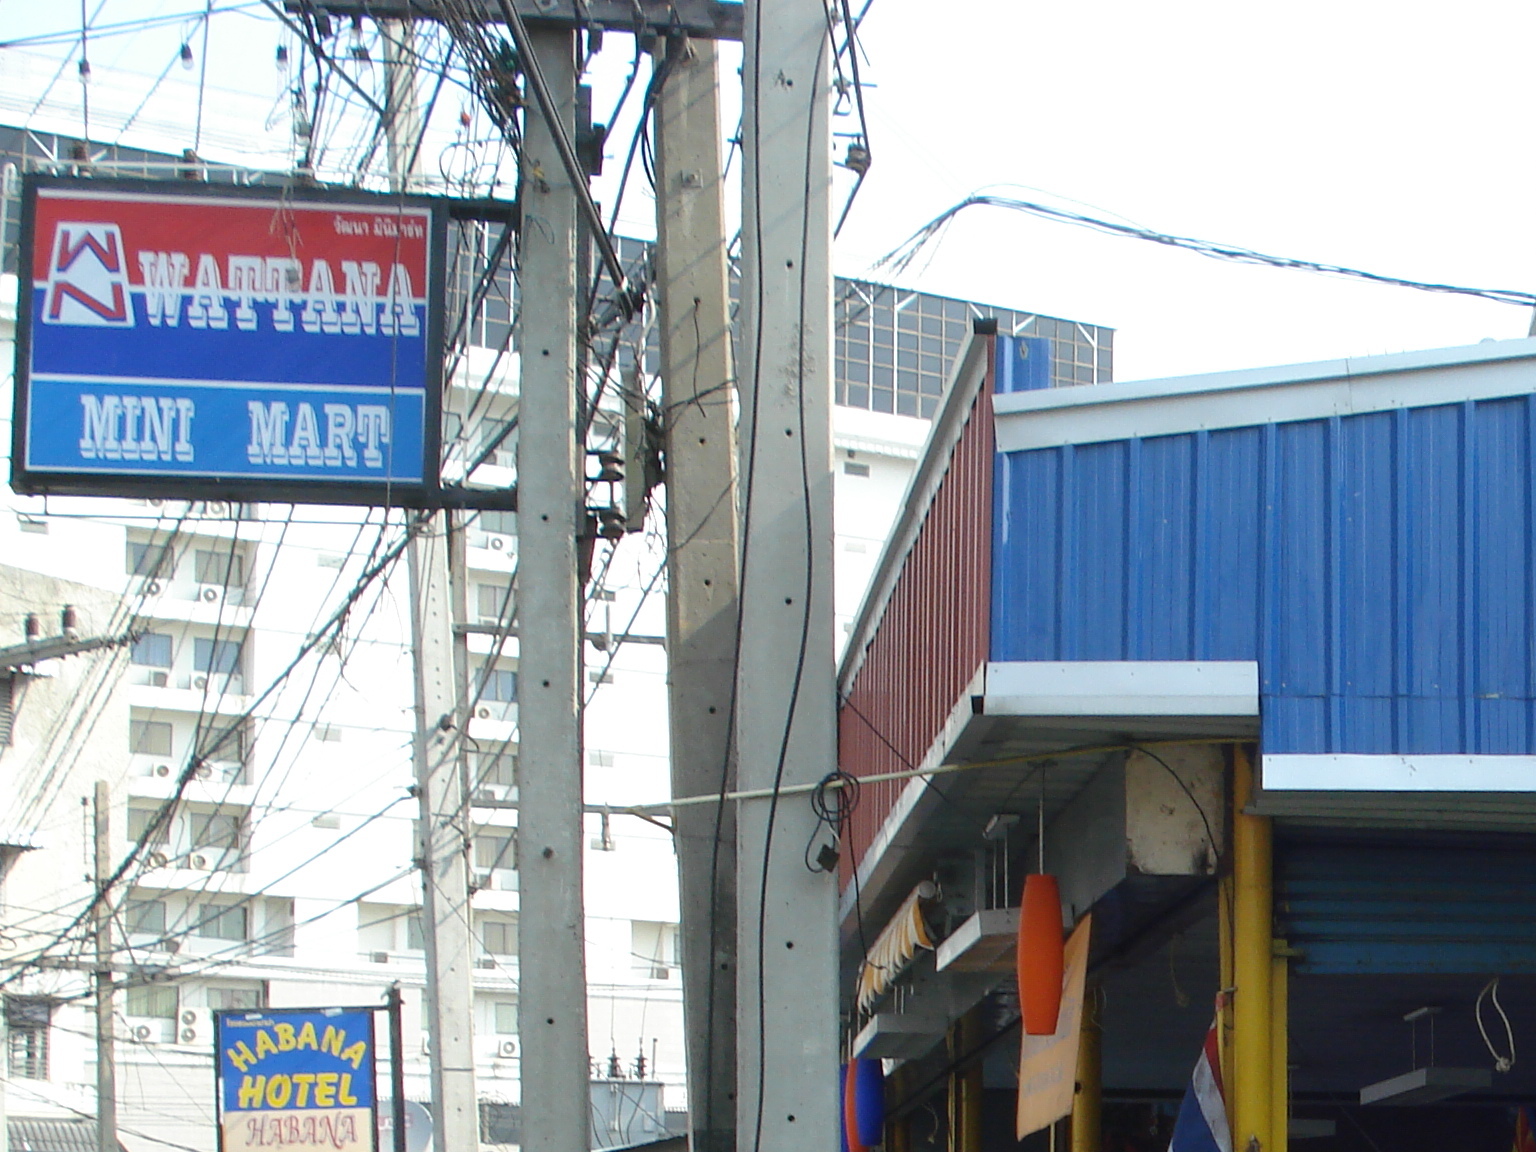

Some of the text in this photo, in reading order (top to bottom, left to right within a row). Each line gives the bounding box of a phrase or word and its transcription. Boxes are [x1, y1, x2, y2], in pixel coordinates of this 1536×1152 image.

[138, 251, 420, 336] WATTANA
[79, 394, 392, 468] MINI MART
[226, 1021, 367, 1073] HABANA
[238, 1073, 358, 1109] HOTEL
[245, 1111, 358, 1149] HABANA
